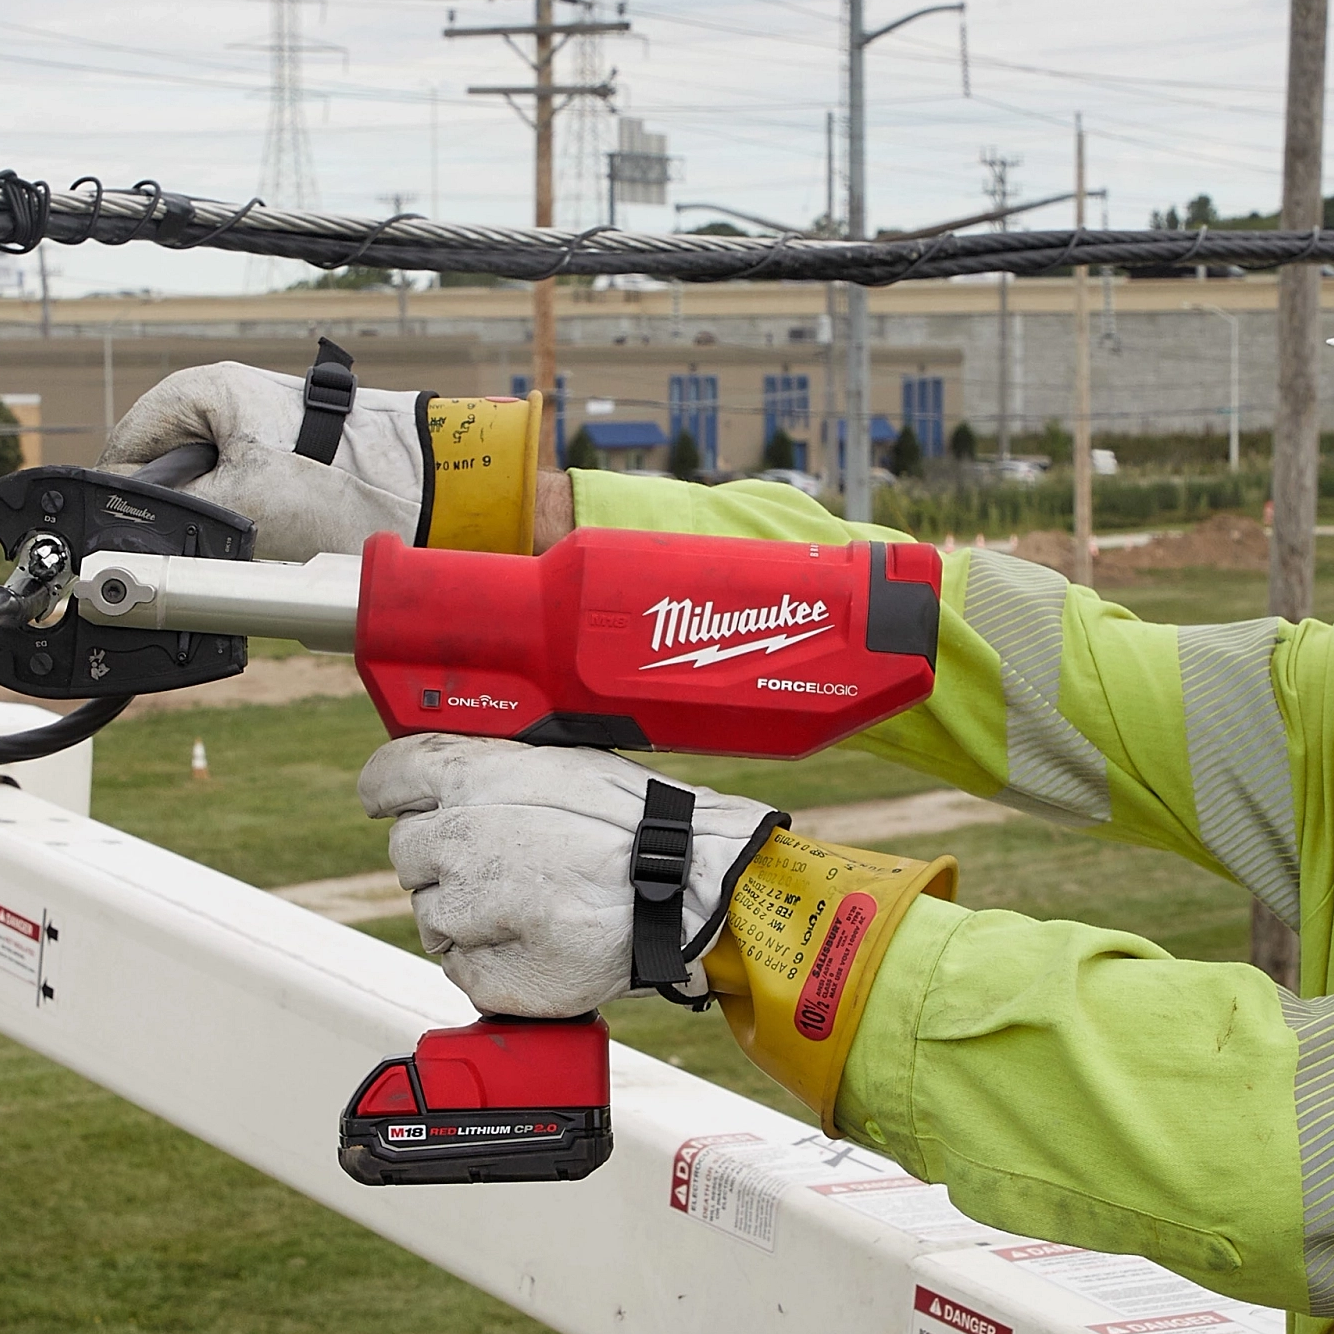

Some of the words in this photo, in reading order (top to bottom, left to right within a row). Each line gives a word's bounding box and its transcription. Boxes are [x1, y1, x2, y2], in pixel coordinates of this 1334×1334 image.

[453, 458, 475, 470] JUN
[482, 455, 492, 467] 6
[105, 494, 156, 522] Milwaukee
[44, 515, 56, 524] D3
[642, 594, 829, 652] Milwaukee
[35, 640, 47, 648] D3
[757, 678, 858, 697] FORCELOGIC
[774, 833, 795, 846] 2019
[753, 854, 773, 868] 2018
[791, 861, 807, 873] OCT
[826, 868, 838, 880] 6
[766, 888, 783, 900] 27
[784, 893, 801, 906] JUN
[775, 905, 794, 920] FEB
[747, 924, 764, 942] 08
[767, 918, 786, 933] MAY
[747, 945, 763, 962] 09
[765, 936, 791, 957] JAN
[812, 917, 843, 979] SALISBURY
[764, 955, 788, 973] APR
[793, 951, 804, 965] 6
[829, 982, 838, 999] MAX
[835, 967, 843, 981] USE
[840, 947, 851, 966] VOLT
[848, 925, 861, 947] 1000V
[858, 916, 866, 925] AC
[787, 967, 798, 980] 8
[822, 980, 831, 999] CLASS
[390, 1127, 424, 1138] M18
[429, 1125, 511, 1136] REDLITHIUM
[514, 1123, 558, 1134] CP2.0
[1127, 1315, 1221, 1333] DANGER
